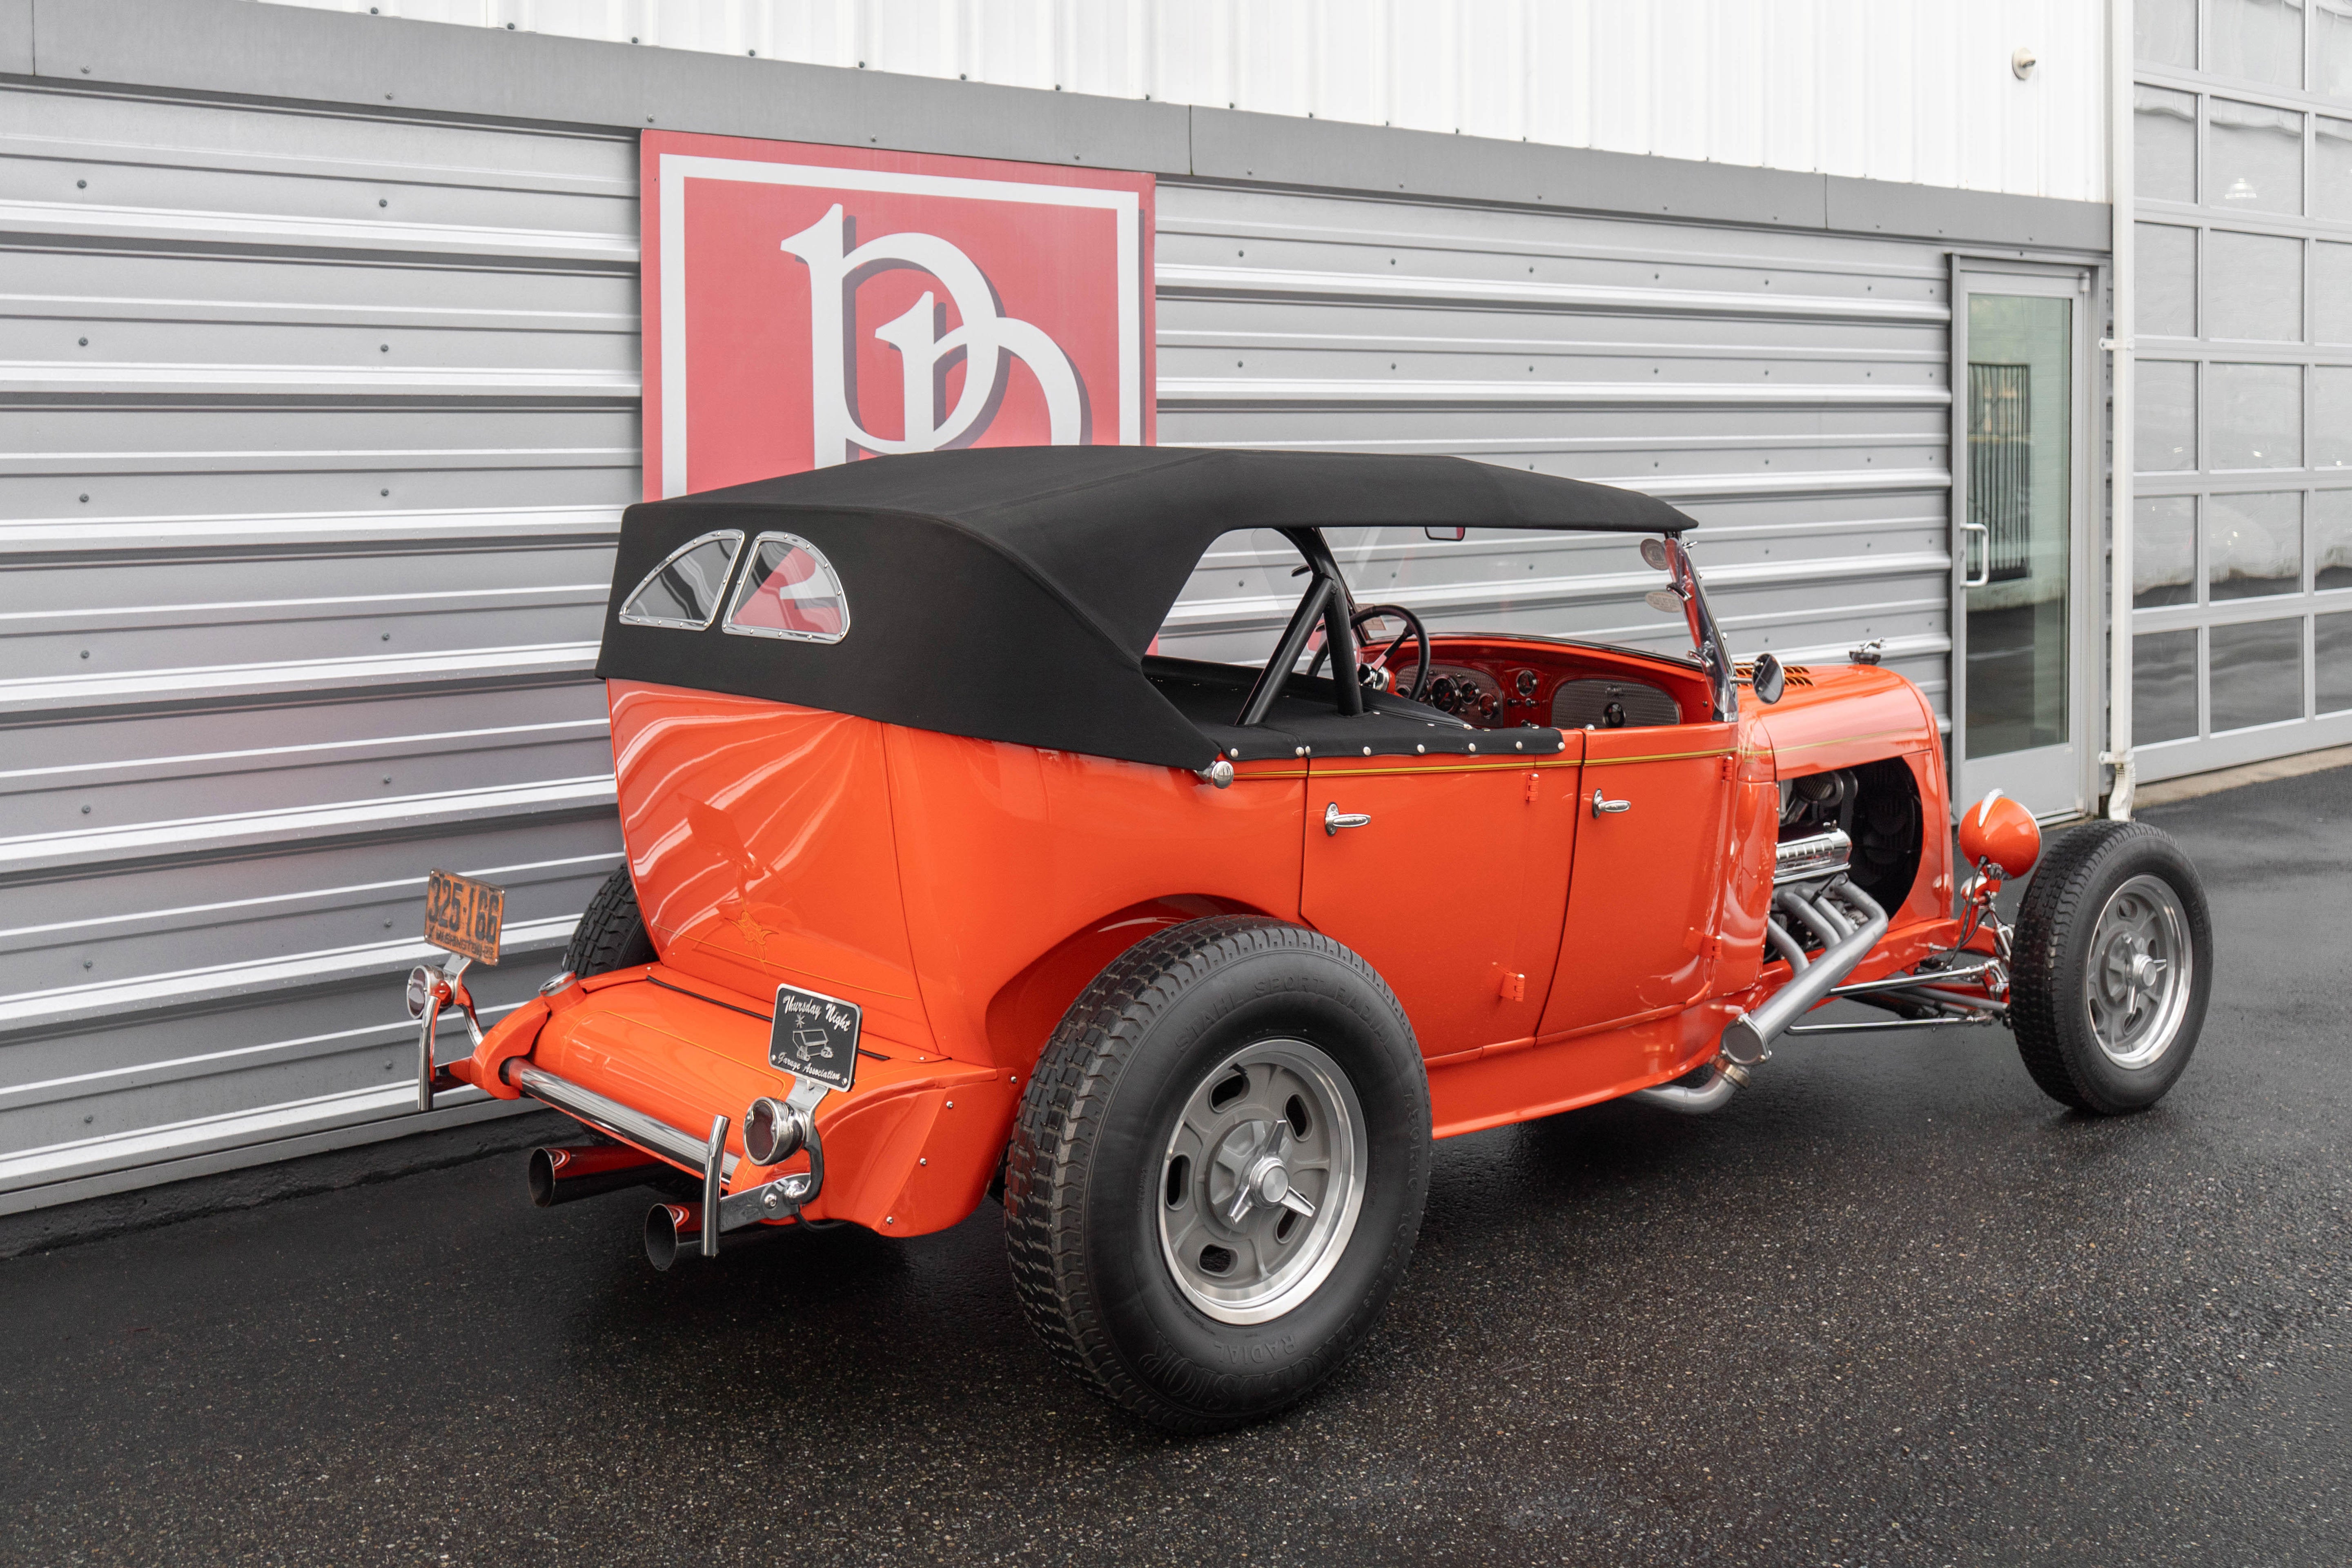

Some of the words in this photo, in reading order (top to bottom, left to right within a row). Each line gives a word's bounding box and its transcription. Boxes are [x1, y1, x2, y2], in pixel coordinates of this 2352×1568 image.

[783, 996, 821, 1020] Thursday
[826, 1003, 851, 1031] Night
[778, 1052, 801, 1069] Garage
[803, 1062, 840, 1080] Association
[1213, 1335, 1296, 1365] RADIAL
